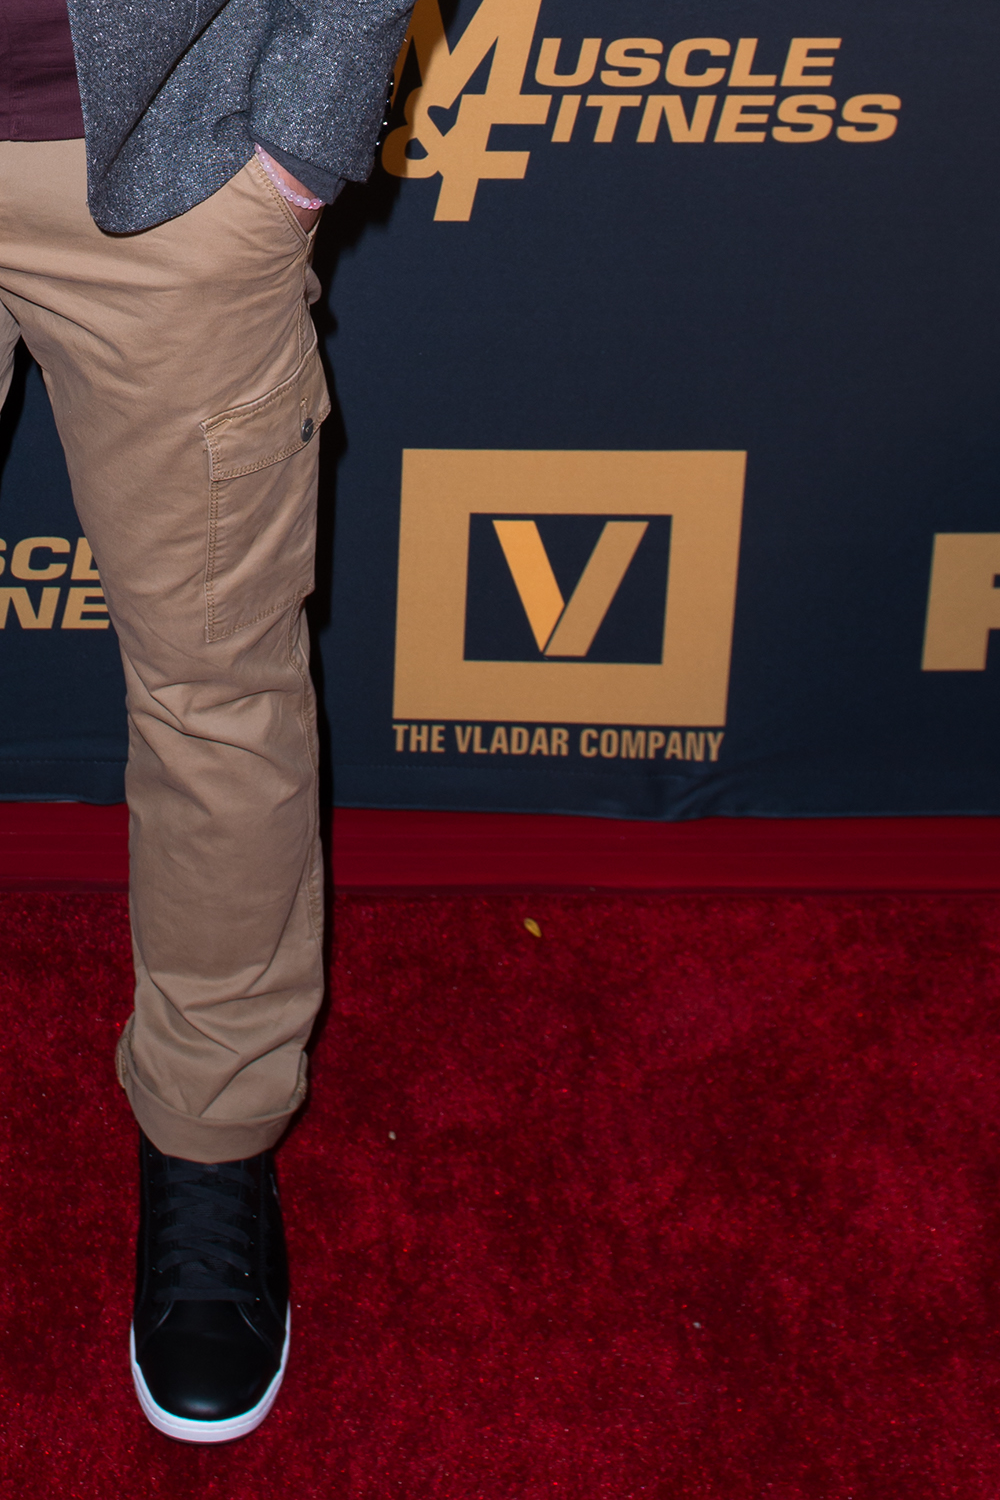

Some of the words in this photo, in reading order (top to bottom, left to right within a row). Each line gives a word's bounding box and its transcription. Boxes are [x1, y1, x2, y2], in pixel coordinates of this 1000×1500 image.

[492, 520, 649, 656] V
[392, 724, 446, 752] THE
[455, 725, 570, 757] VLADAR
[580, 728, 725, 762] COMPANY
